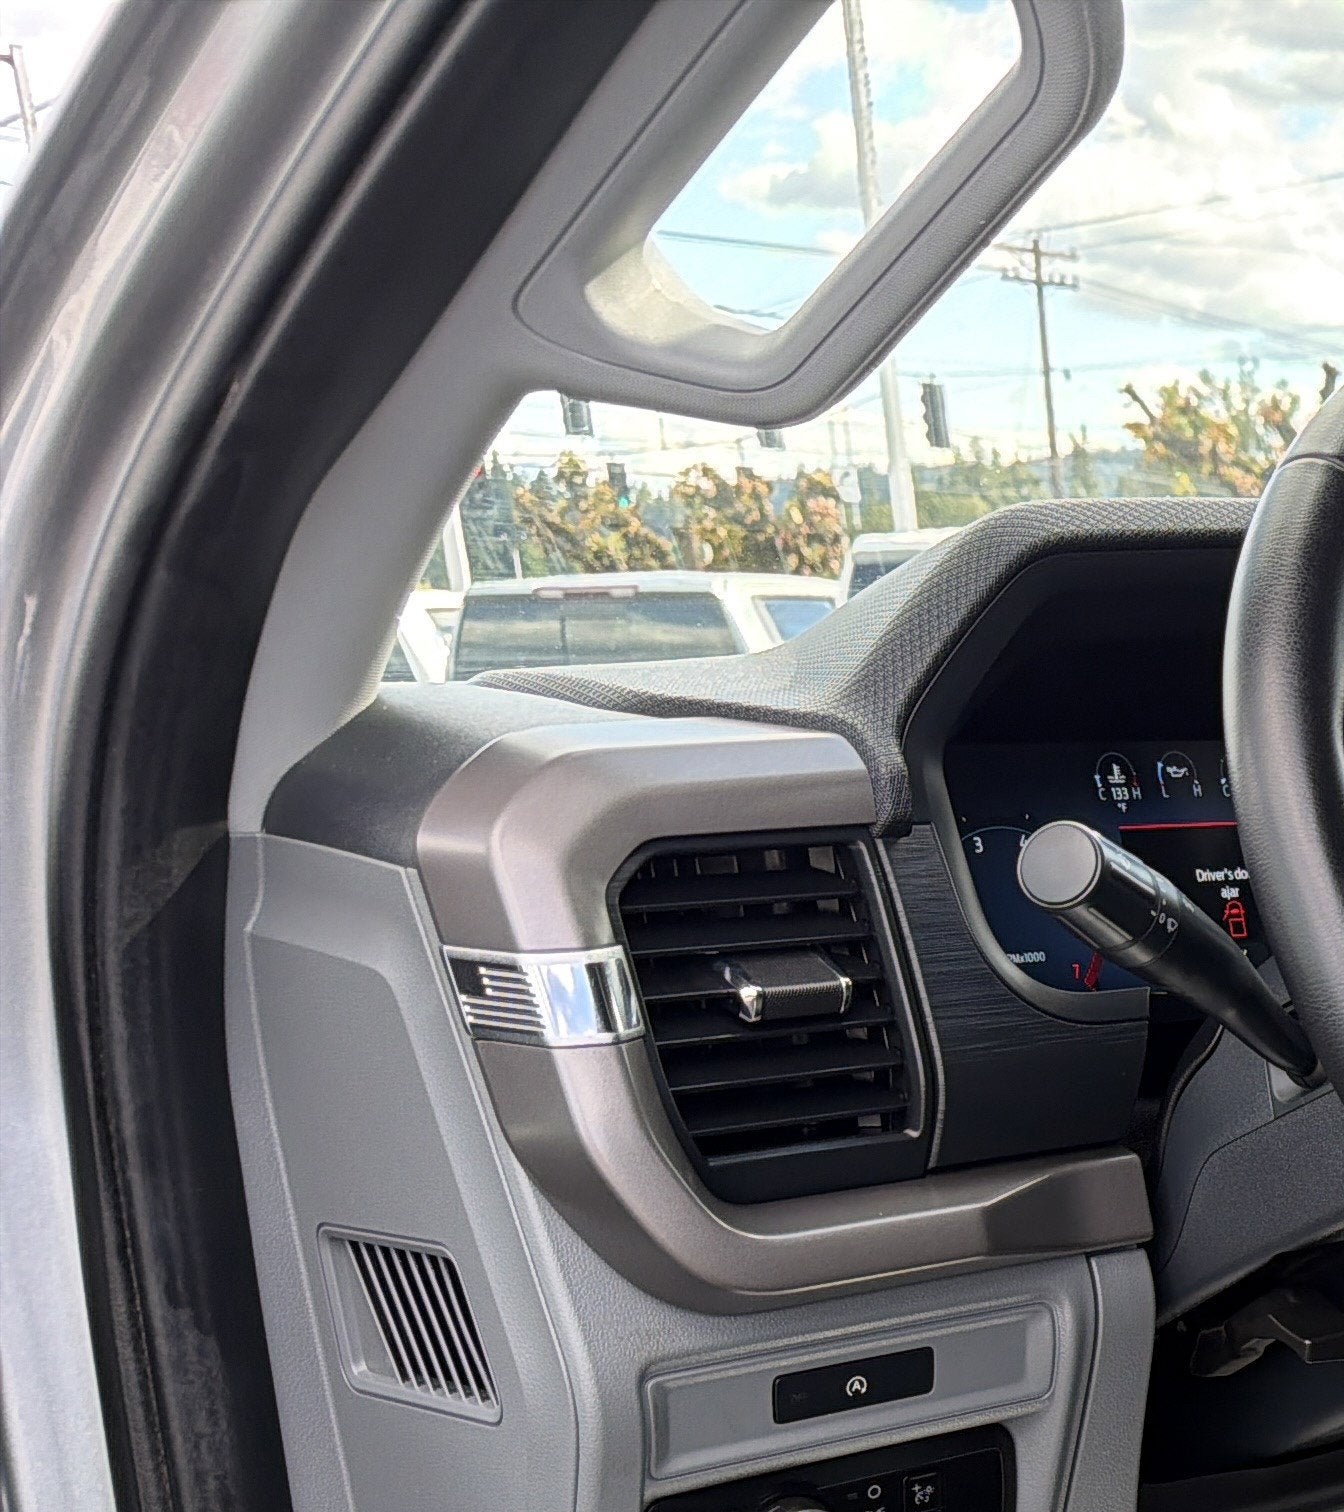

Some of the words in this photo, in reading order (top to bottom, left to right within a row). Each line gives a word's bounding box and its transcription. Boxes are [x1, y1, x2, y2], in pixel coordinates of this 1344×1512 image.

[1111, 787, 1129, 800] 133
[1195, 868, 1235, 883] Driver's
[1221, 884, 1240, 900] ajar
